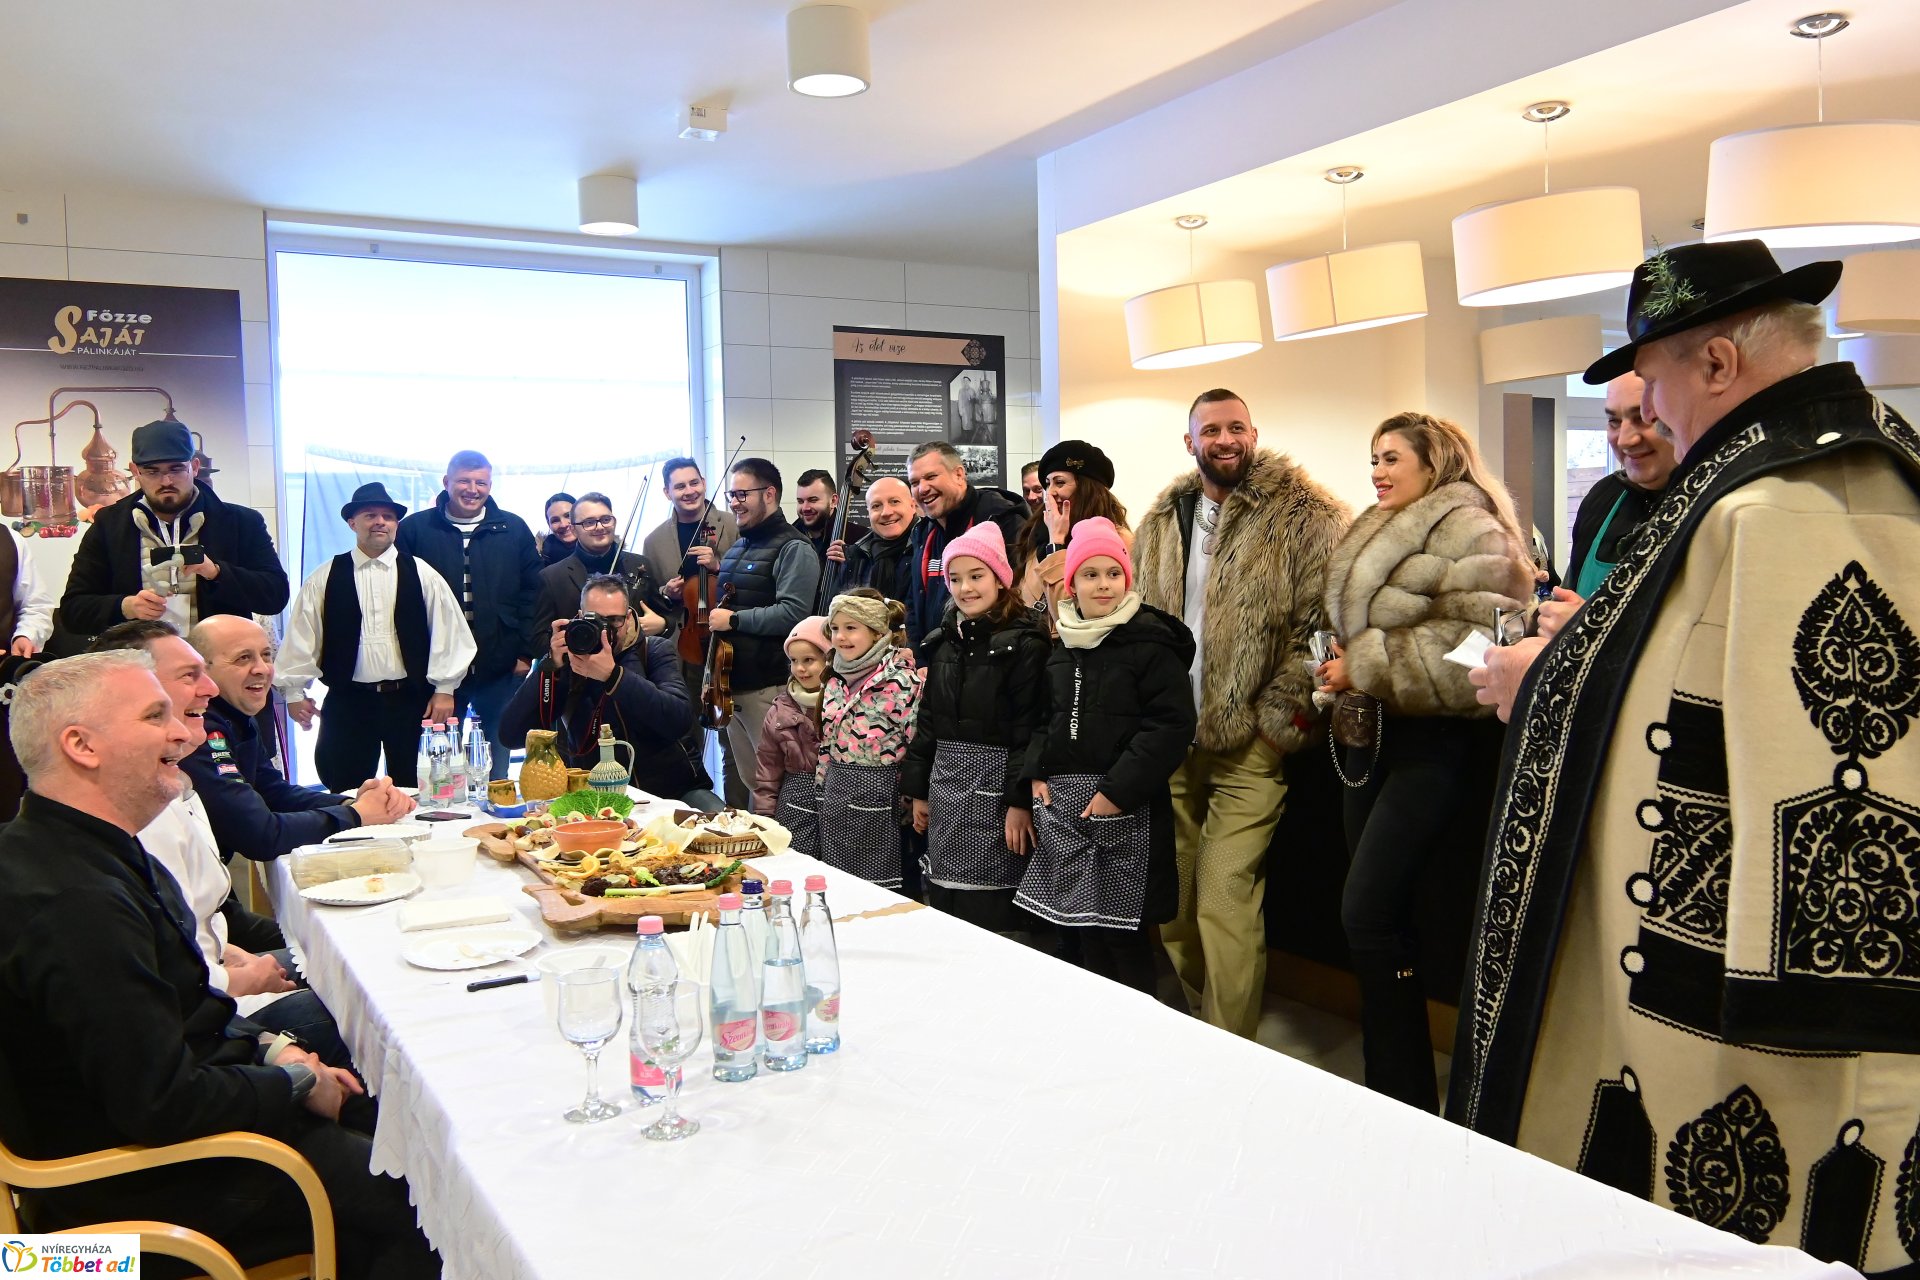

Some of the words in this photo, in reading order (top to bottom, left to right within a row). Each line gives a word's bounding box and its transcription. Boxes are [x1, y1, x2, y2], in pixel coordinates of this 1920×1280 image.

[86, 309, 153, 324] Főzze
[77, 347, 137, 356] PÁLINKÁJÁT
[543, 678, 551, 703] Canon
[1069, 718, 1079, 740] COME
